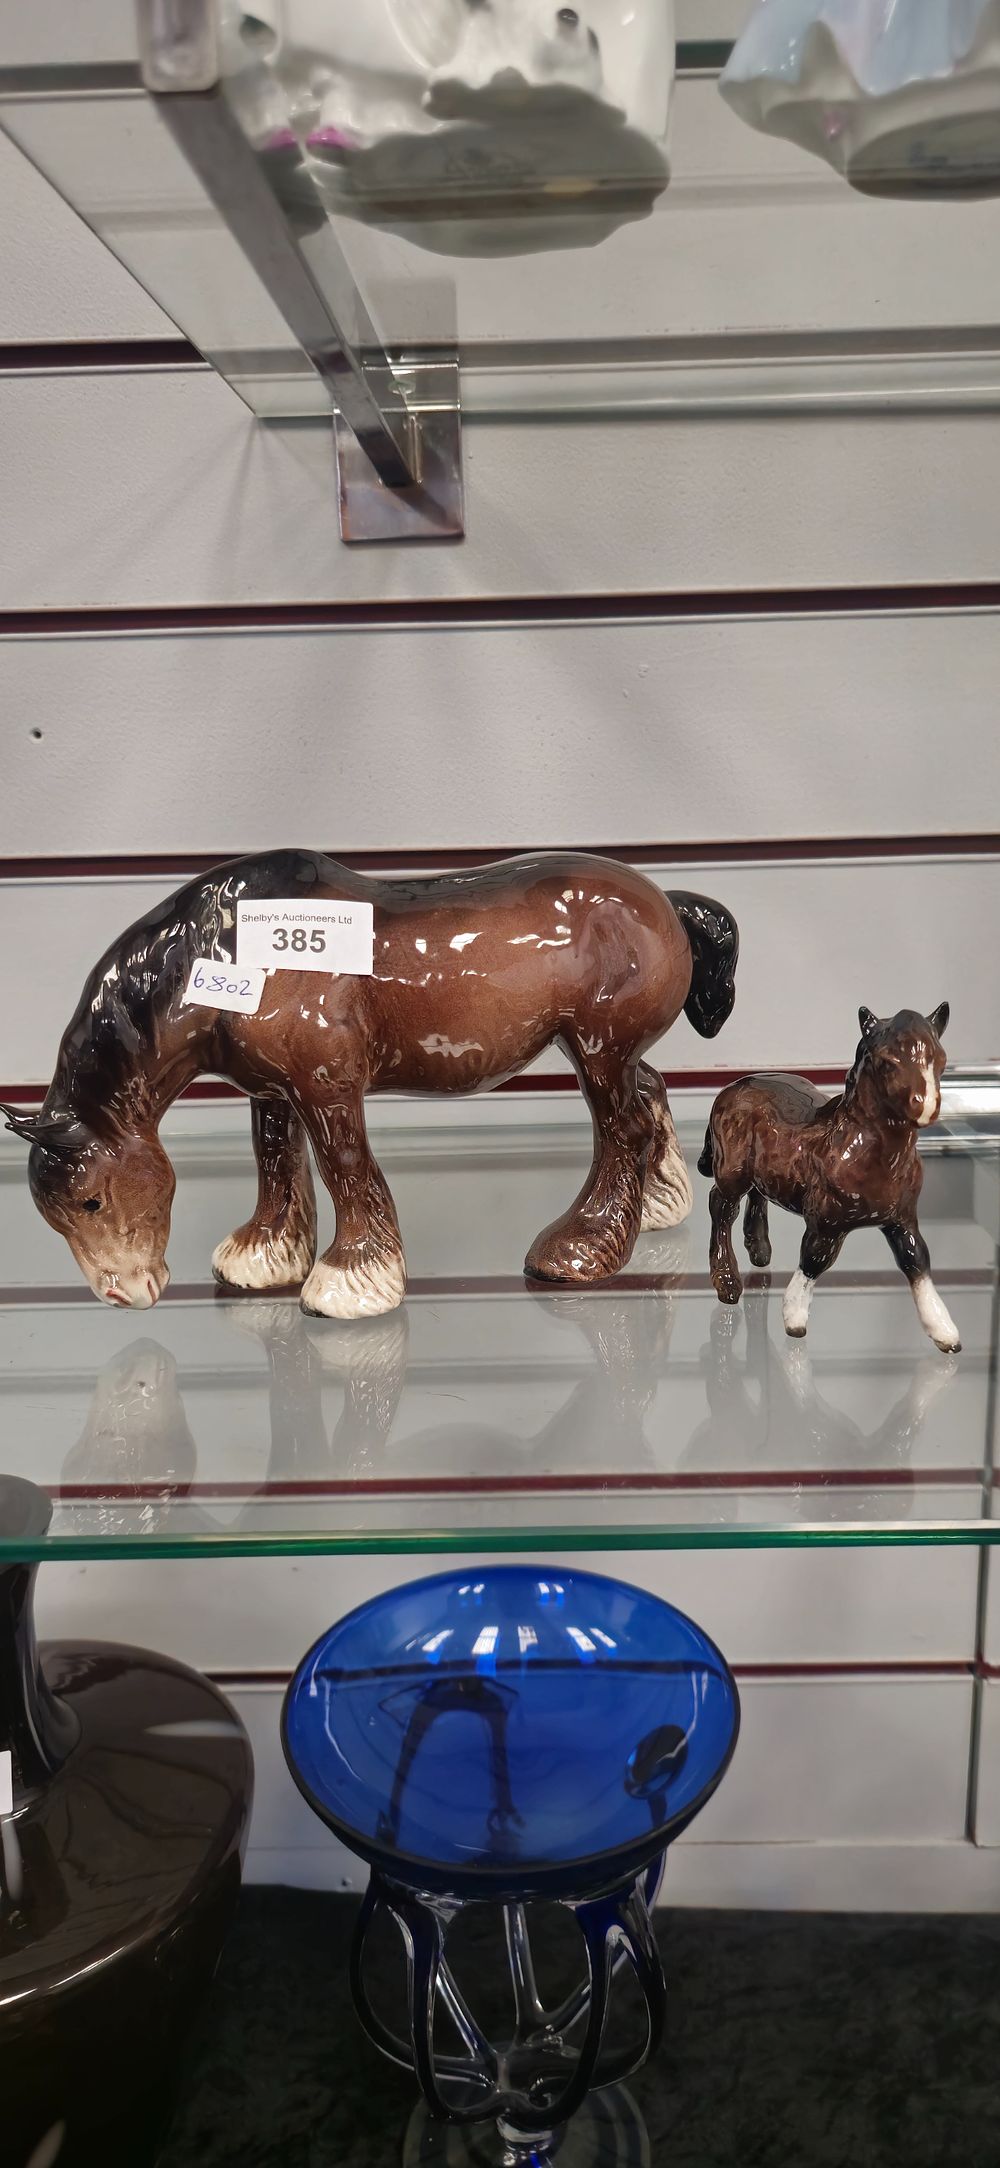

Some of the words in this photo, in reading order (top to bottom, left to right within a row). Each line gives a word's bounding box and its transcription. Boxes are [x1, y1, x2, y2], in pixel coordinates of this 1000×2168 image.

[241, 913, 280, 924] Shelby's
[282, 913, 336, 924] Auctioneers
[338, 915, 352, 925] Ltd
[272, 928, 326, 953] 385
[193, 967, 253, 996] 6802
